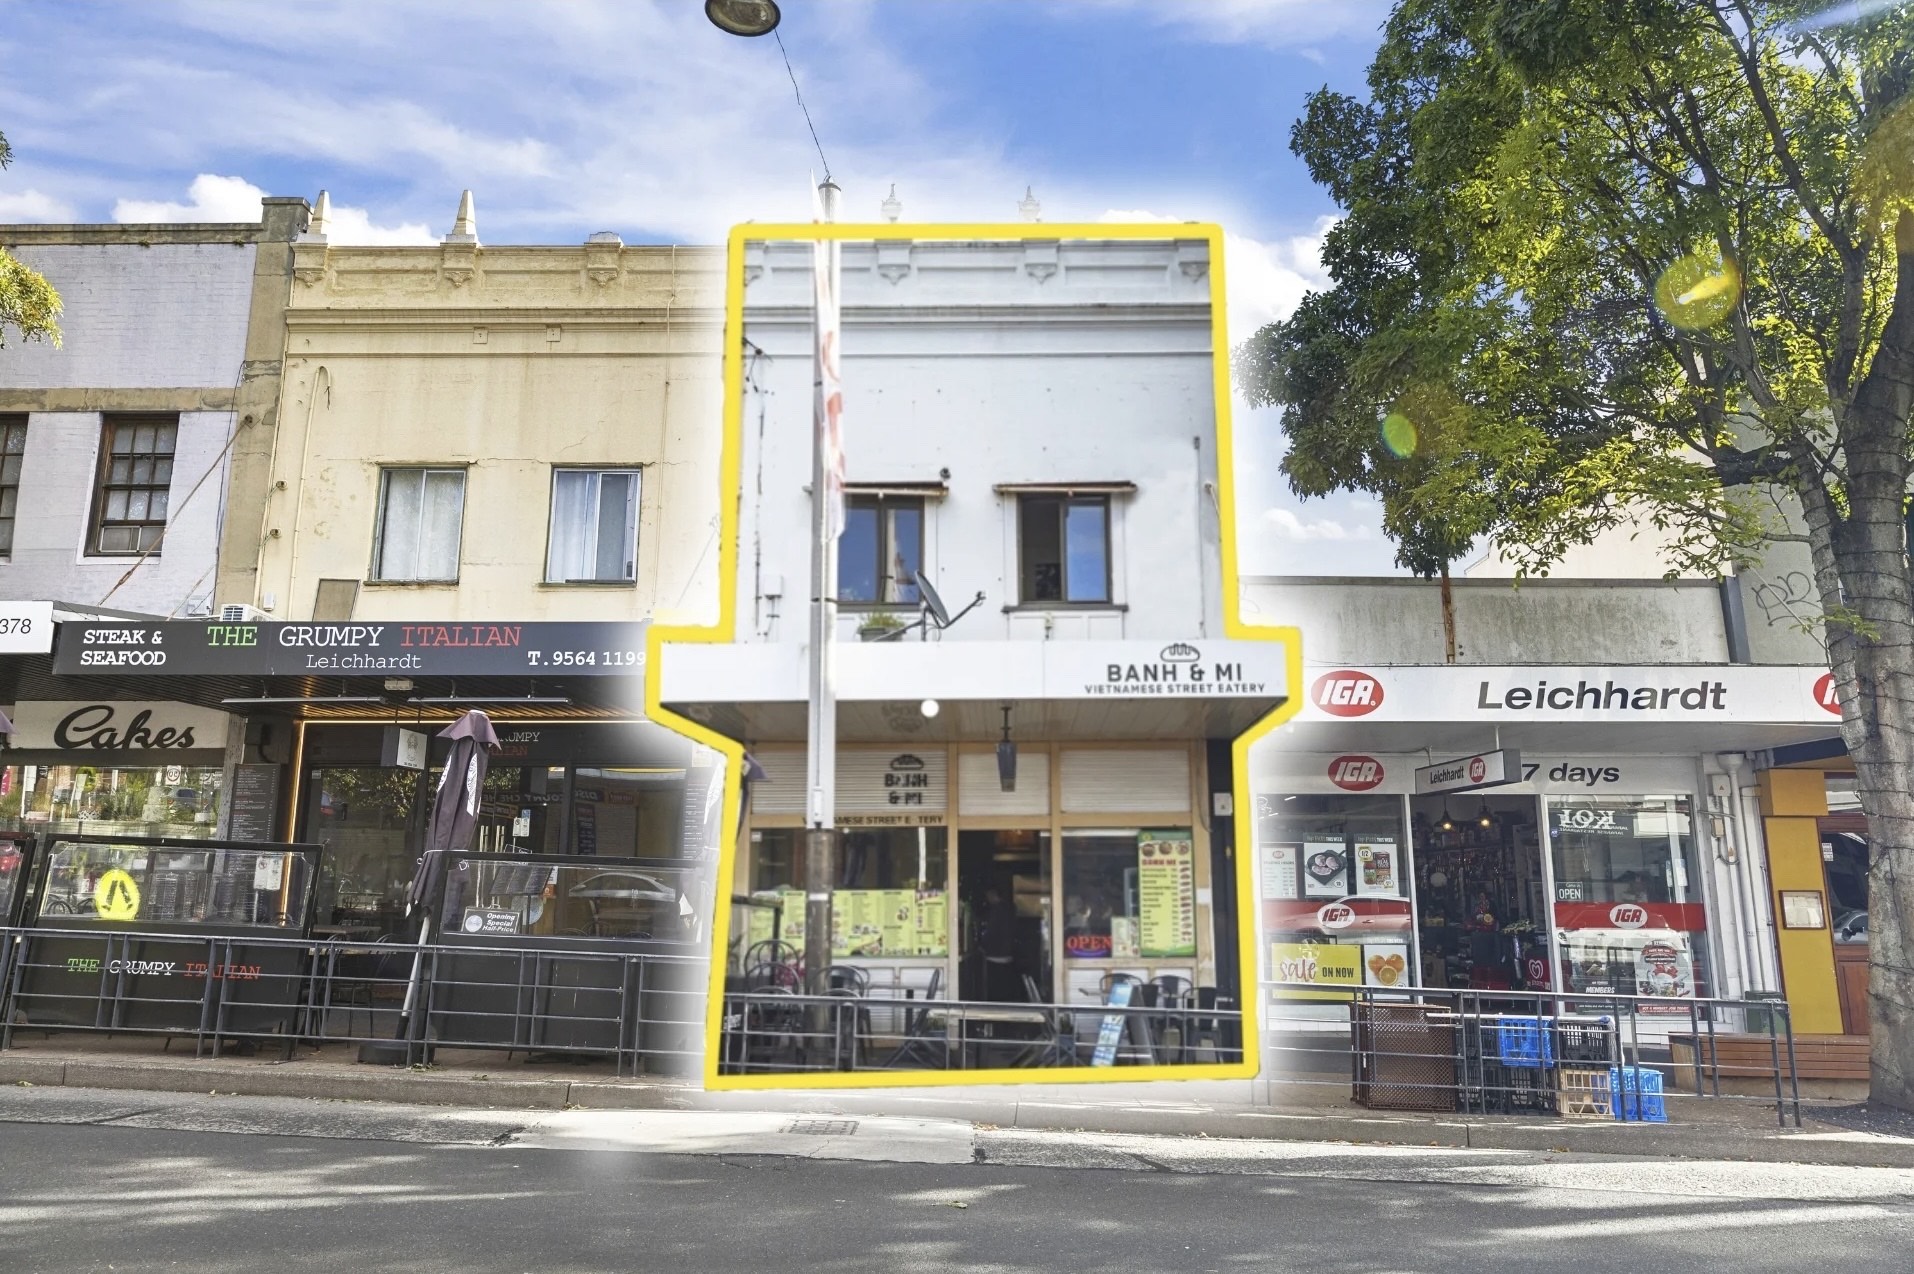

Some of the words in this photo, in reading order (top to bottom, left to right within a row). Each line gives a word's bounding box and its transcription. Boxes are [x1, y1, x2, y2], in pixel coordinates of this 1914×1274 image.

[0, 618, 32, 635] 378
[83, 629, 146, 645] STEAK
[151, 630, 163, 645] &
[207, 625, 258, 647] THE
[279, 626, 384, 647] GRUMPY
[400, 626, 522, 647] ITALIAN
[80, 650, 167, 666] SEAFOOD
[306, 653, 422, 669] Leichhardt
[527, 650, 596, 667] T.9564
[602, 650, 647, 666] 1199
[1107, 663, 1178, 682] BANH
[1189, 663, 1205, 682] &
[1215, 663, 1242, 681] MI
[1084, 684, 1163, 694] VIETNAMESE
[1167, 683, 1213, 694] STREET
[1218, 683, 1265, 694] EATERY
[1319, 679, 1376, 706] IGA
[1477, 680, 1728, 710] Leichhardt
[54, 704, 196, 749] Cakes
[1334, 761, 1379, 783] IGA
[1429, 765, 1465, 785] Leichhardt
[1471, 762, 1485, 778] IGA
[1521, 762, 1541, 782] 7
[1548, 762, 1620, 787] days
[865, 815, 902, 825] STREET
[1558, 888, 1581, 899] OPEN
[486, 919, 513, 927] Special
[1322, 908, 1350, 922] IGA
[1614, 908, 1642, 922] IGA
[1066, 933, 1113, 950] OPEN
[67, 958, 100, 973] THE
[1280, 958, 1316, 983] sale
[1322, 966, 1333, 978] ON
[1335, 966, 1354, 978] NOW
[1585, 986, 1615, 994] MEMBERS
